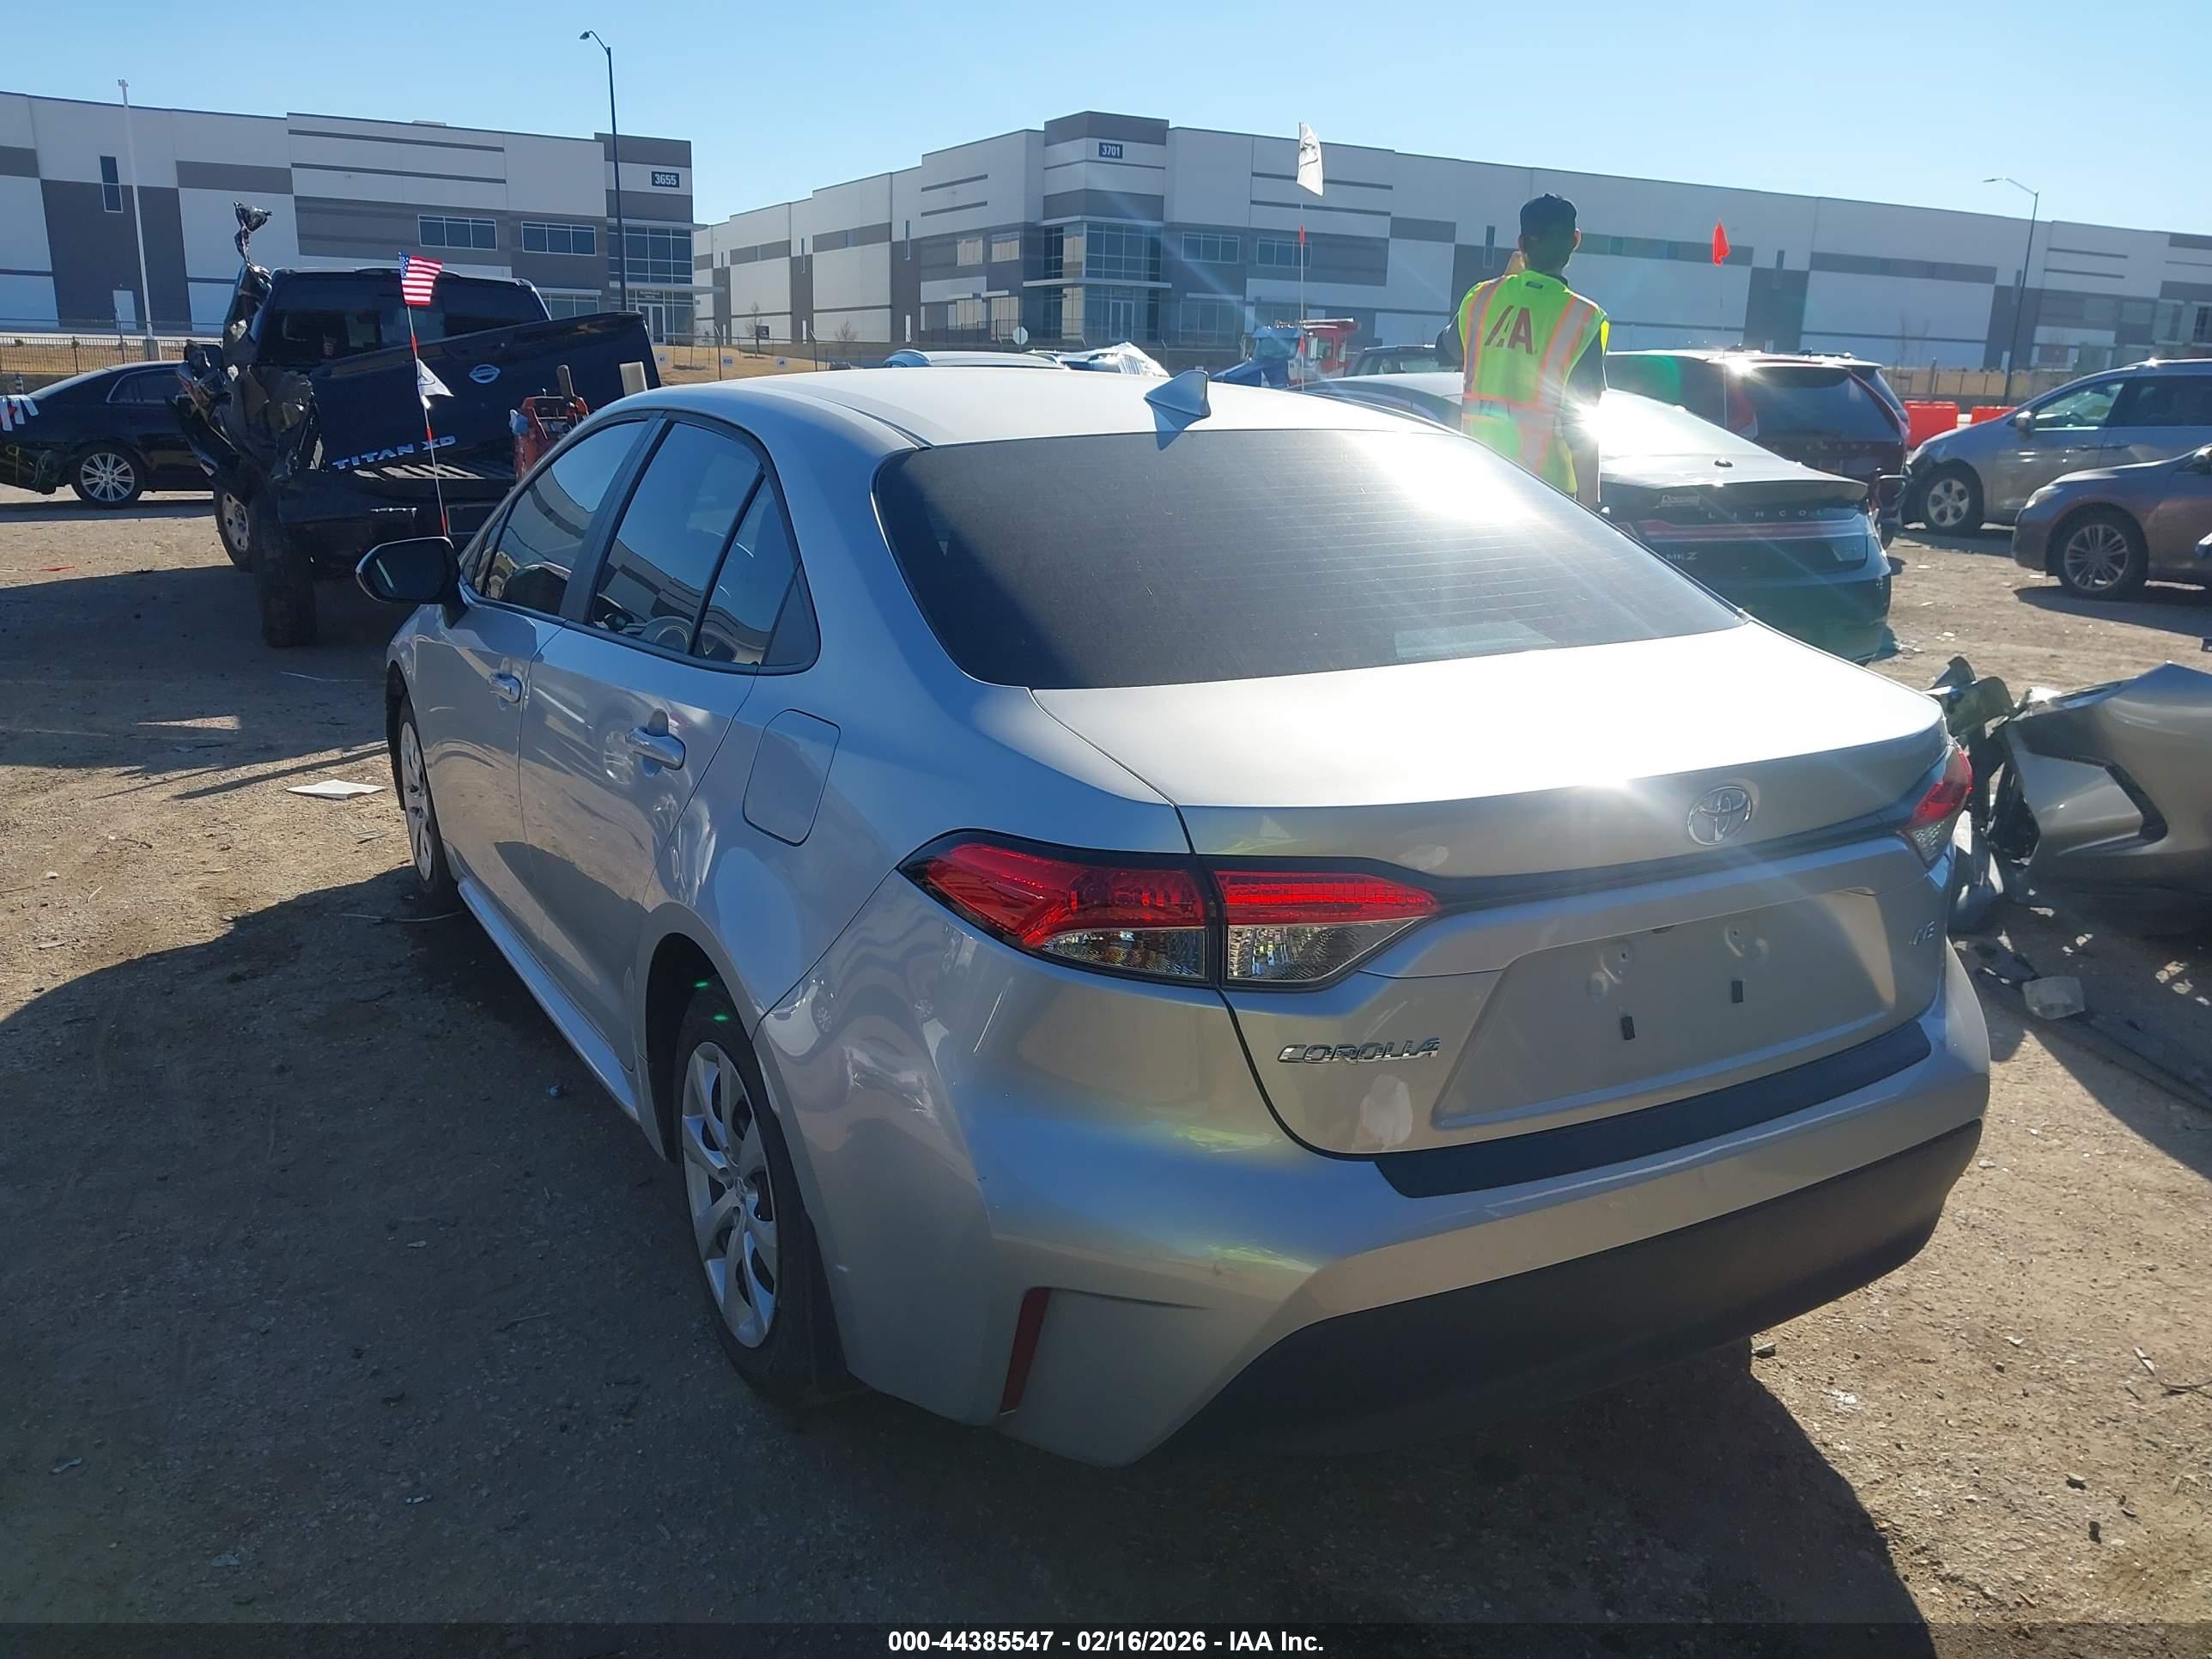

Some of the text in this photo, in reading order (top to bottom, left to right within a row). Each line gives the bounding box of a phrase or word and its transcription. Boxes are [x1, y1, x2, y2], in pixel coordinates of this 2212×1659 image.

[1102, 144, 1120, 156] 3701
[654, 173, 677, 185] 3655
[332, 435, 455, 470] TITAN XD
[1707, 507, 1829, 520] LINCOL
[1278, 1037, 1441, 1065] COROLLA
